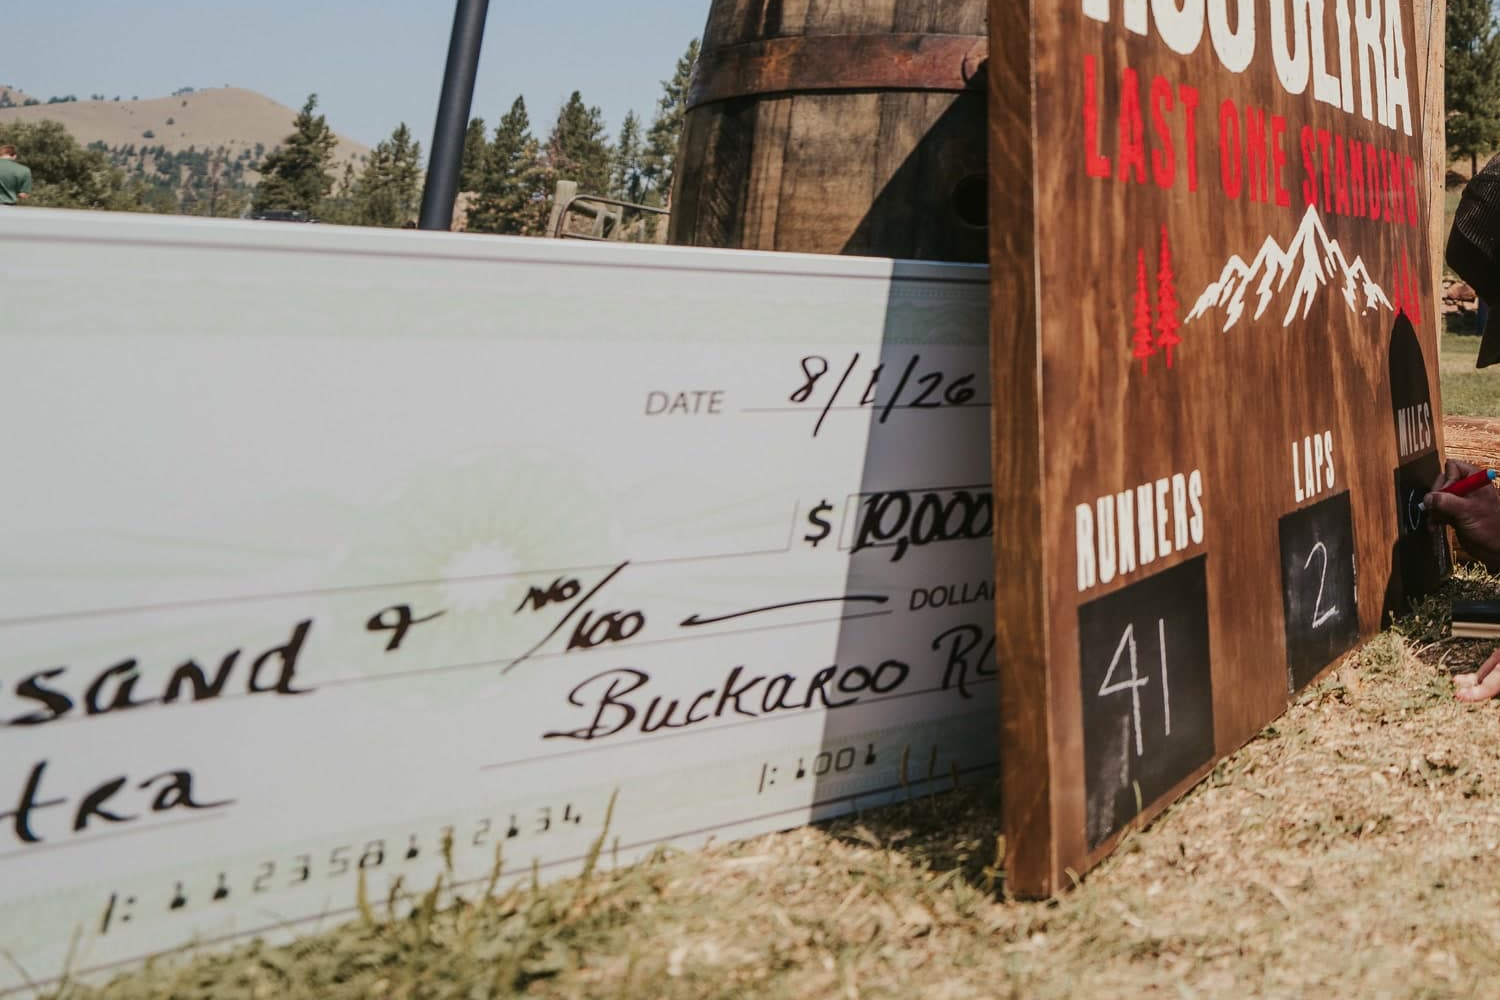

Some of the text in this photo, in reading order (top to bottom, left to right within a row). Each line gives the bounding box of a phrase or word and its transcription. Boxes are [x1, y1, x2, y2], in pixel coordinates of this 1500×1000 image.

[1083, 55, 1418, 228] LAST ONE STANDING
[645, 353, 976, 438] DATE 8/1/26
[1398, 402, 1431, 457] MILES
[1292, 431, 1335, 502] LAPS
[1074, 468, 1204, 592] RUNNERS
[909, 580, 995, 611] DOLLA
[1303, 540, 1338, 628] 2
[1097, 616, 1172, 757] 41
